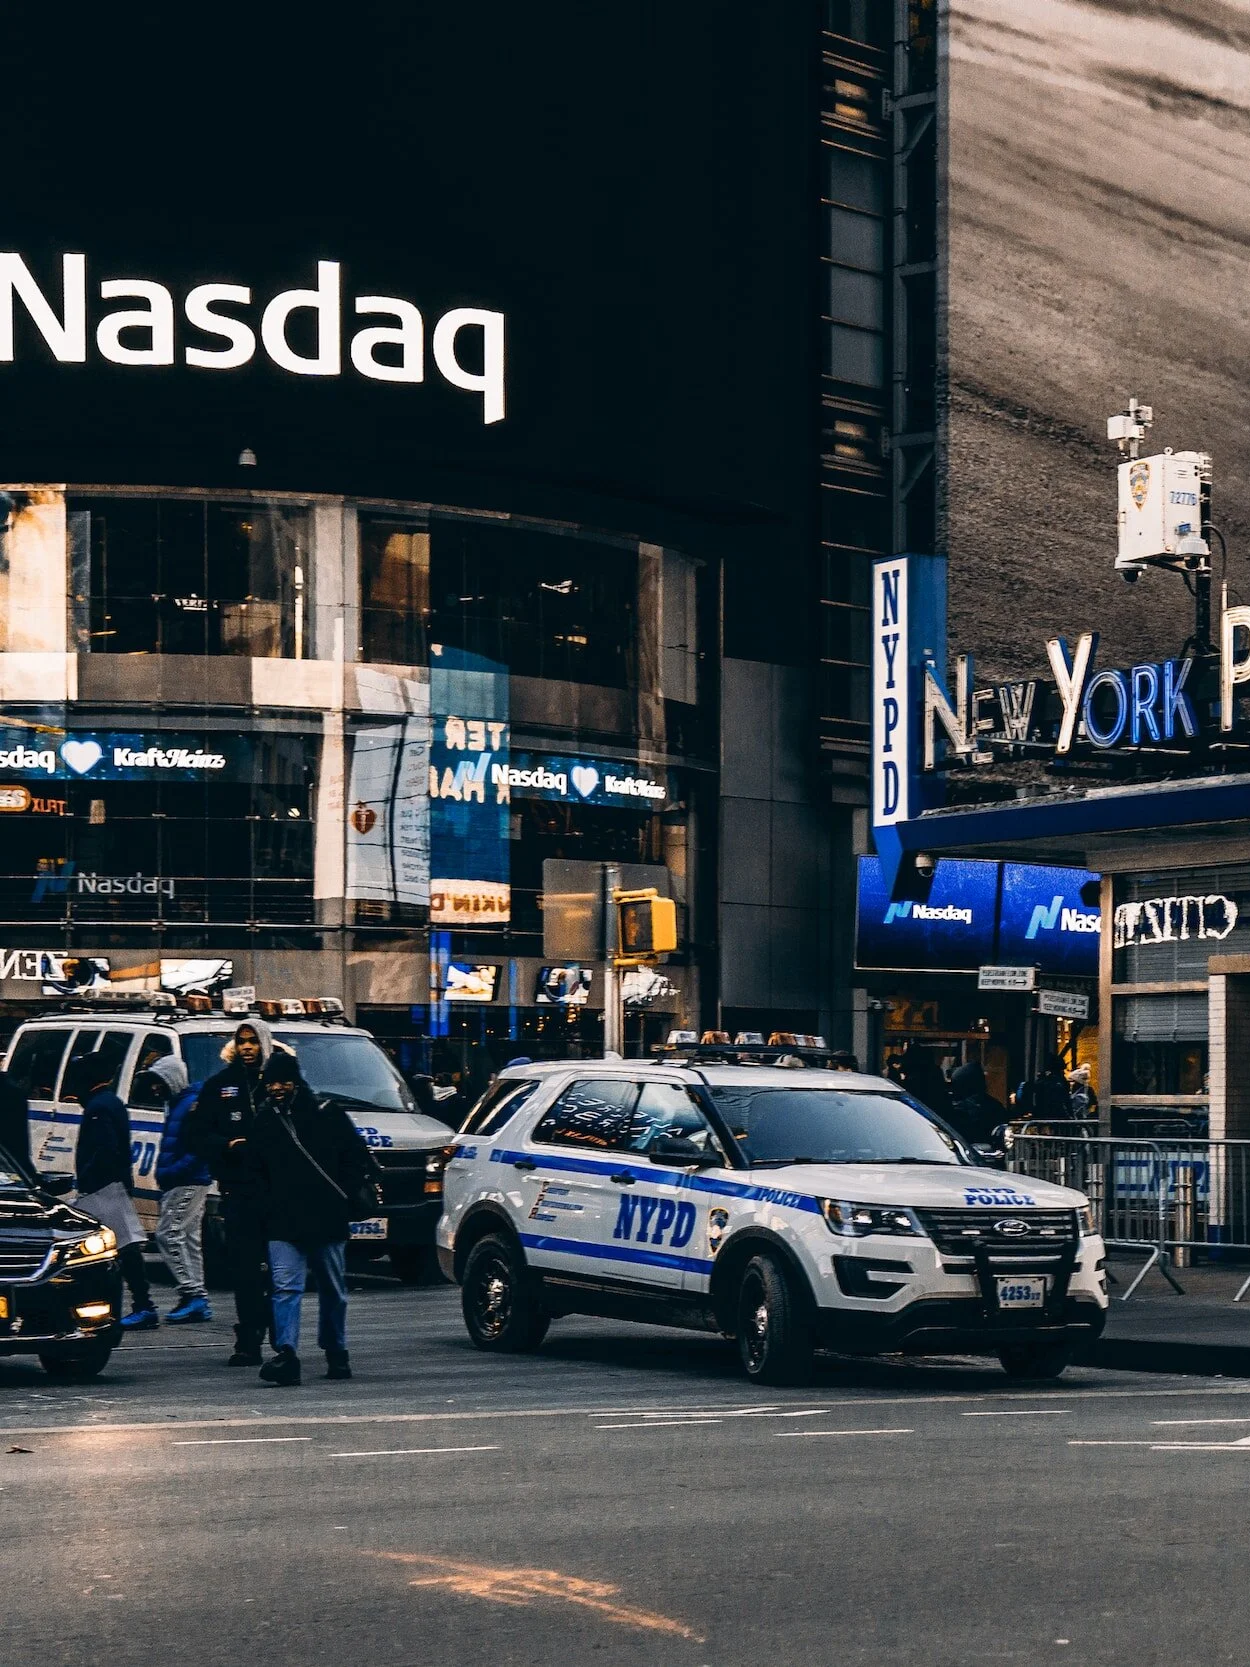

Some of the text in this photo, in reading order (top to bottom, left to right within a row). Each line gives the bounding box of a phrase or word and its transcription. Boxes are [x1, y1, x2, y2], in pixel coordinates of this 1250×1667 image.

[0, 252, 505, 424] Nasdaq
[881, 569, 900, 816] NYPD
[923, 652, 1036, 772] NEW
[1046, 631, 1197, 753] YORK
[491, 764, 568, 796] Nasdaq
[78, 871, 175, 899] Nasdaq
[912, 904, 1101, 933] Nasdaq Nas
[758, 1187, 801, 1208] POLICE
[963, 1194, 1037, 1206] POLICE
[613, 1193, 697, 1248] NYPD
